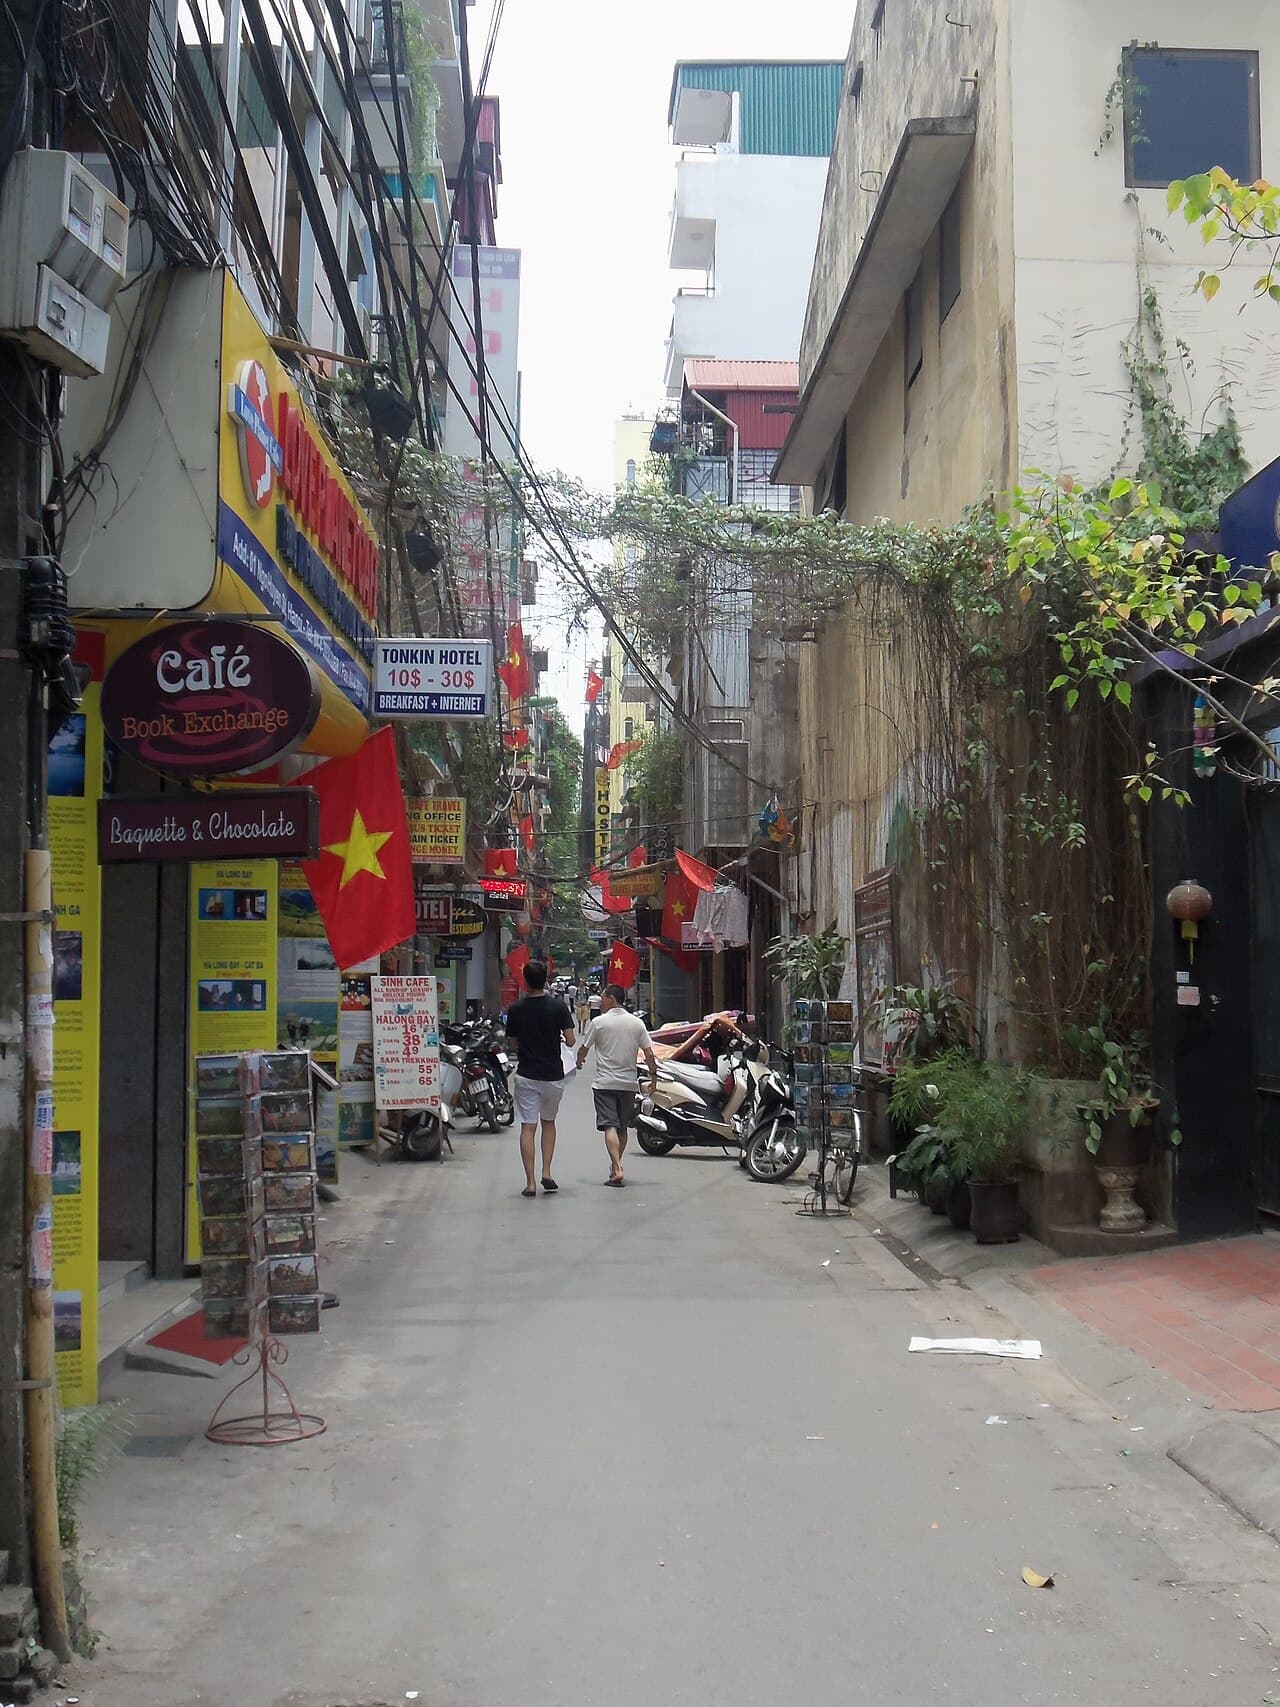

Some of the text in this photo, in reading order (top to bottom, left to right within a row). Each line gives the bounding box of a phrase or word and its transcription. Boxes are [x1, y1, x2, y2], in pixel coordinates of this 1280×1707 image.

[382, 648, 483, 665] TONKIN HOTEL
[156, 644, 251, 693] Café
[388, 668, 421, 688] 10$
[441, 670, 474, 690] 30$
[380, 695, 482, 711] BREAKFAST + INTERNET
[122, 707, 289, 740] Book Exchange
[433, 801, 461, 811] TRAVEL
[111, 816, 186, 852] Baguette
[192, 819, 204, 840] &
[209, 809, 295, 840] Chocolate
[429, 825, 461, 833] TICKET
[410, 835, 459, 844] AIN TICKET
[380, 978, 430, 987] SINH CAFE
[376, 1015, 436, 1025] HALONG BAY
